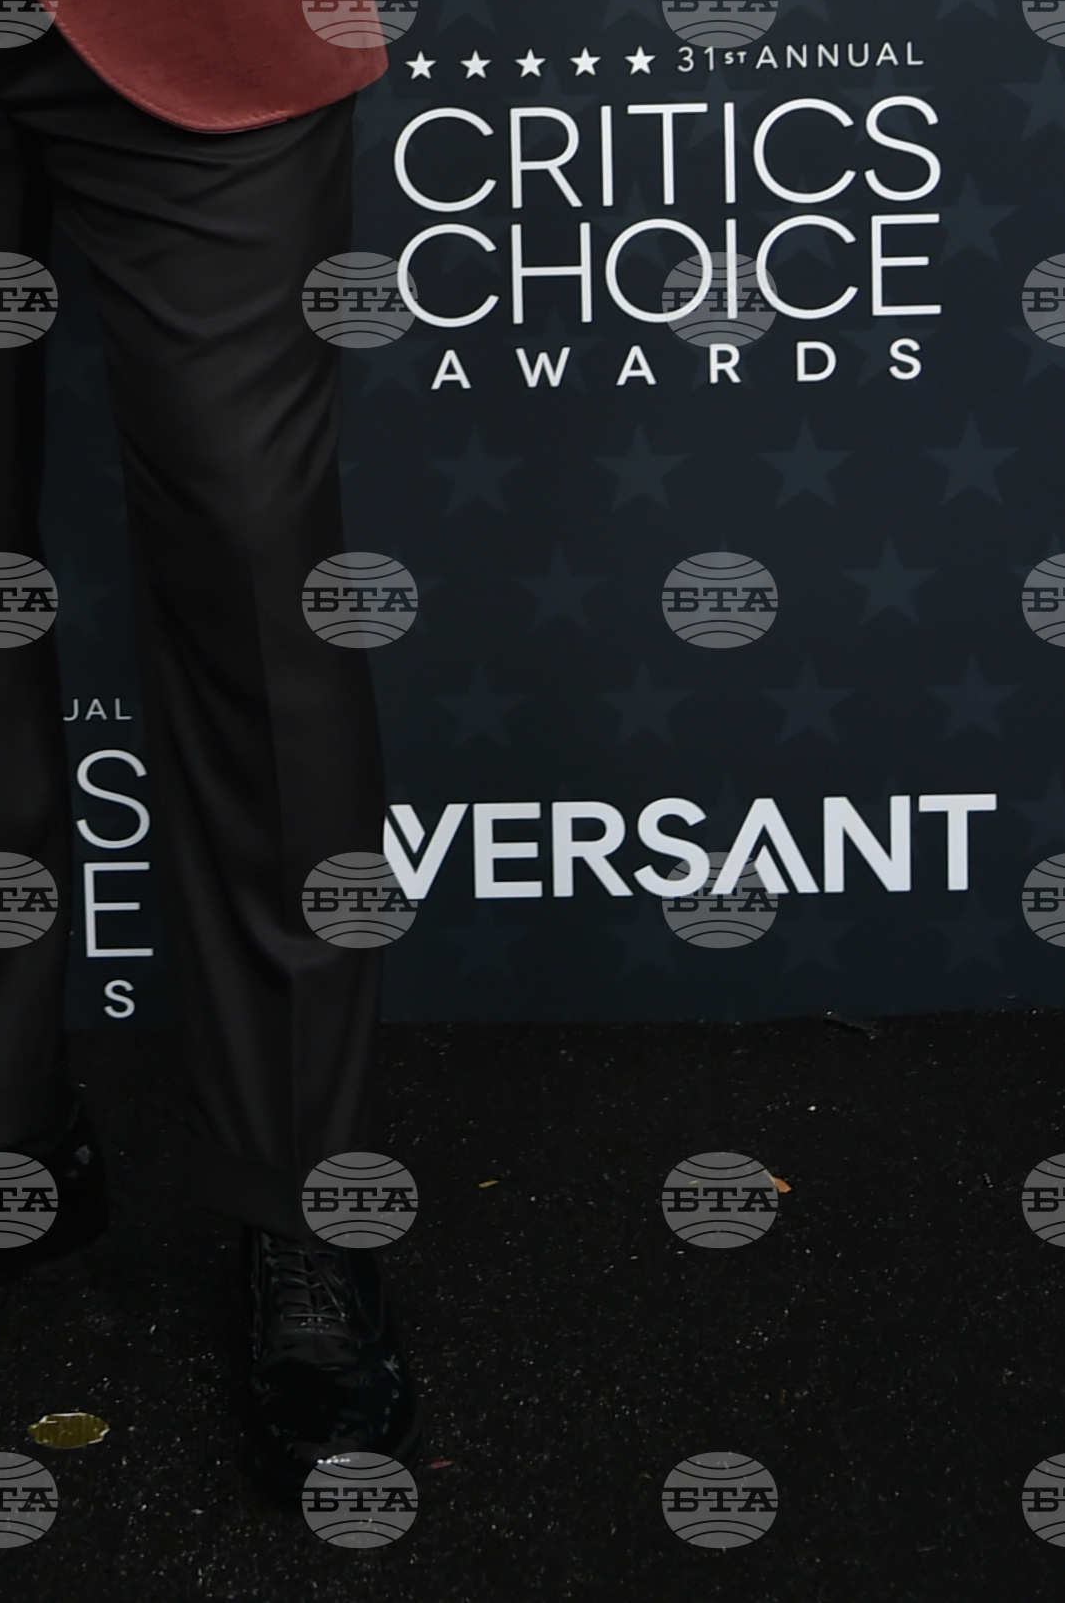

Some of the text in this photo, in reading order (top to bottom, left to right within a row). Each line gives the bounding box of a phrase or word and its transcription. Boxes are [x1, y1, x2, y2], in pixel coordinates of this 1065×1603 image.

[755, 41, 924, 70] ANNUAL
[394, 95, 942, 212] CRITICS
[397, 214, 942, 328] CHOICE
[431, 338, 922, 390] AWARDS
[383, 793, 997, 900] VERSANT
